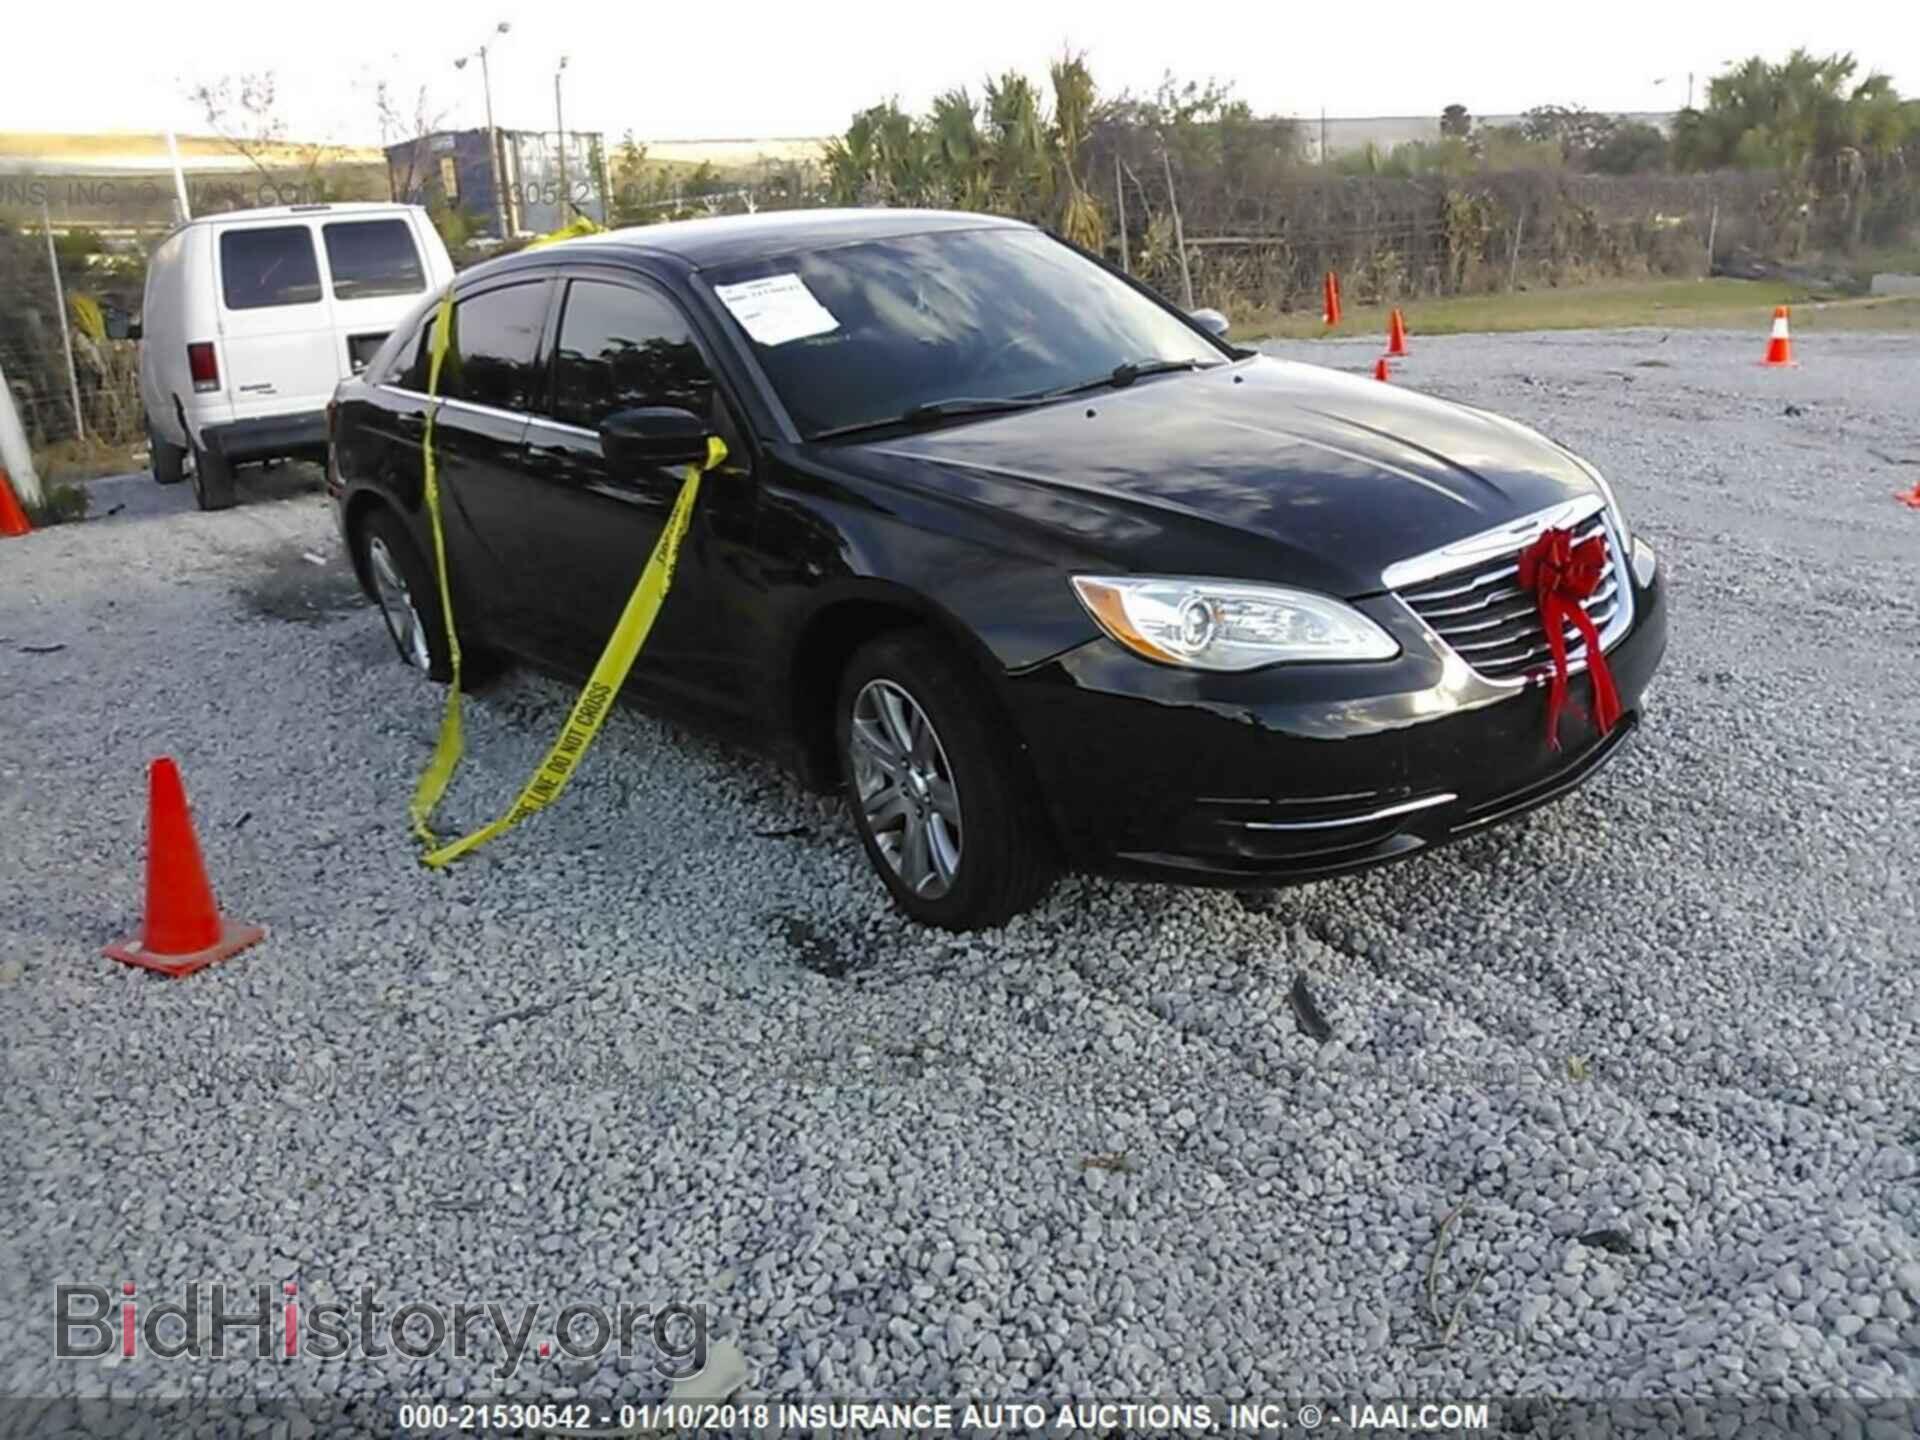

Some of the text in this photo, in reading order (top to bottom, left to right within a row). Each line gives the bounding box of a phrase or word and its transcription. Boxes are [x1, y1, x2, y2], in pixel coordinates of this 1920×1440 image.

[545, 754, 572, 776] DO
[559, 728, 587, 756] NOT
[574, 681, 612, 728] CROSS
